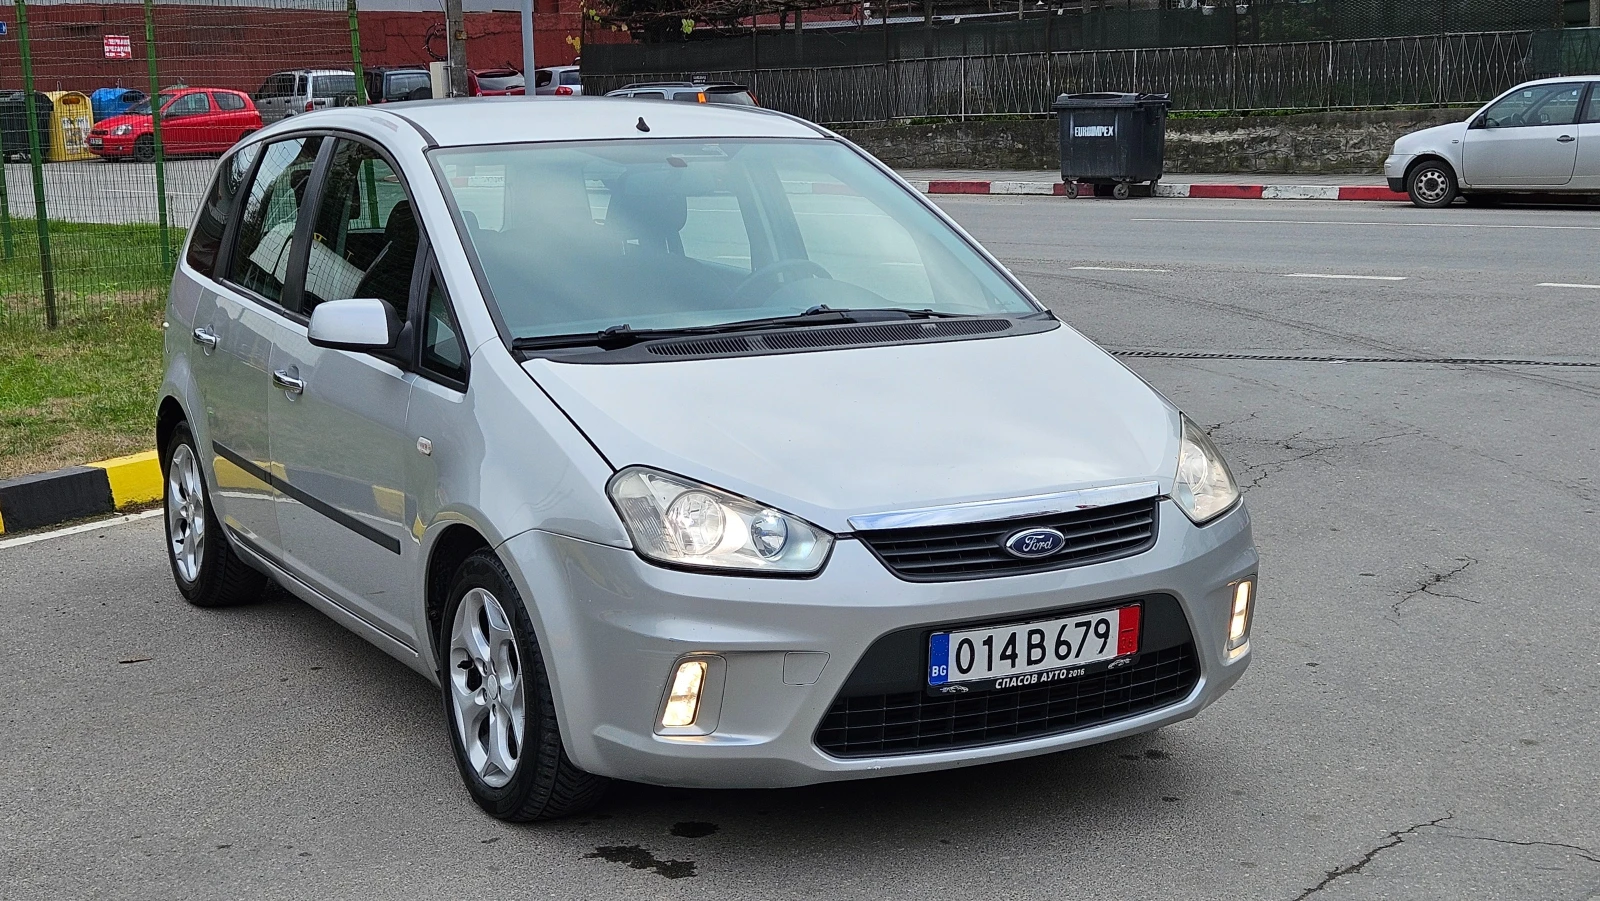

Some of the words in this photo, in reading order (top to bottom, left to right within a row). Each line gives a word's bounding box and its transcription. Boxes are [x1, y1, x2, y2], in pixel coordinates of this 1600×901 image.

[1074, 126, 1114, 137] EUROIMPEX
[1023, 535, 1053, 551] Ford
[956, 618, 1111, 675] 014B679
[932, 665, 947, 677] BG
[995, 673, 1038, 689] СПАСОВ
[1040, 669, 1067, 682] АУТО
[1068, 668, 1085, 678] 2016
